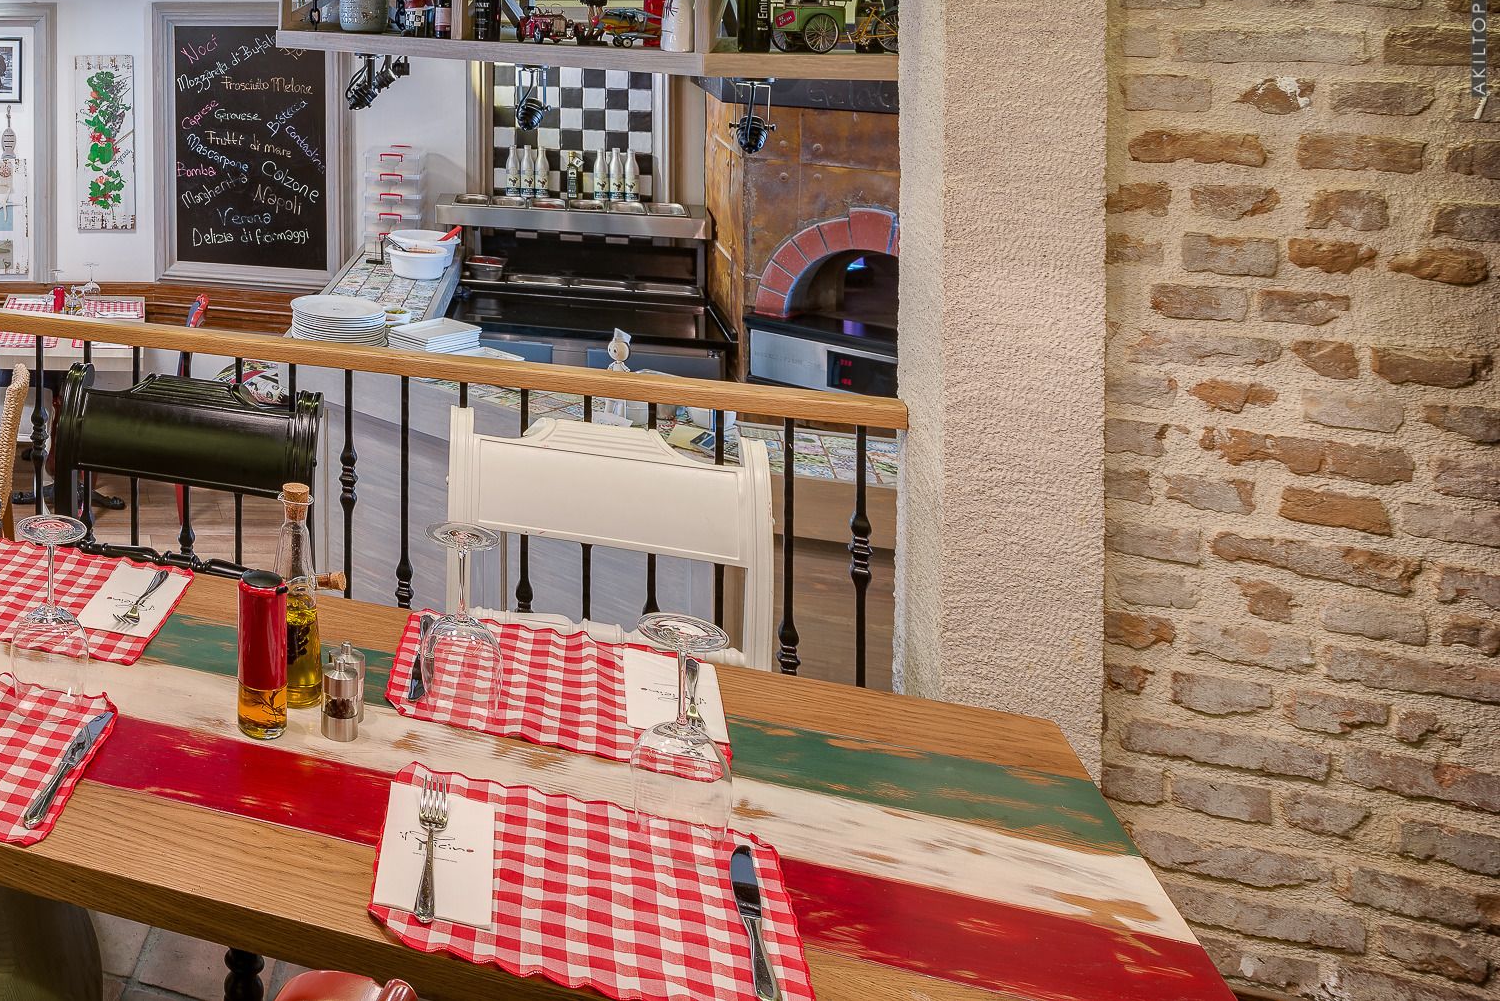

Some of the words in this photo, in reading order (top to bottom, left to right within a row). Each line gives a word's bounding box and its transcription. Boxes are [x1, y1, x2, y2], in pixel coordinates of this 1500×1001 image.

[757, 0, 768, 19] Emir
[181, 33, 218, 64] Noci
[220, 75, 270, 91] Prosciutto
[270, 76, 314, 95] Melone
[186, 133, 249, 172] Mascarpone
[204, 130, 245, 146] Frutti
[249, 133, 261, 152] di
[264, 143, 292, 158] mare
[175, 160, 217, 178] Bomba
[181, 171, 249, 209] Margherita
[252, 183, 303, 216] Napoli
[216, 206, 271, 227] Verona
[192, 227, 235, 247] Delizia
[240, 227, 253, 243] di
[255, 228, 310, 245] formaggi
